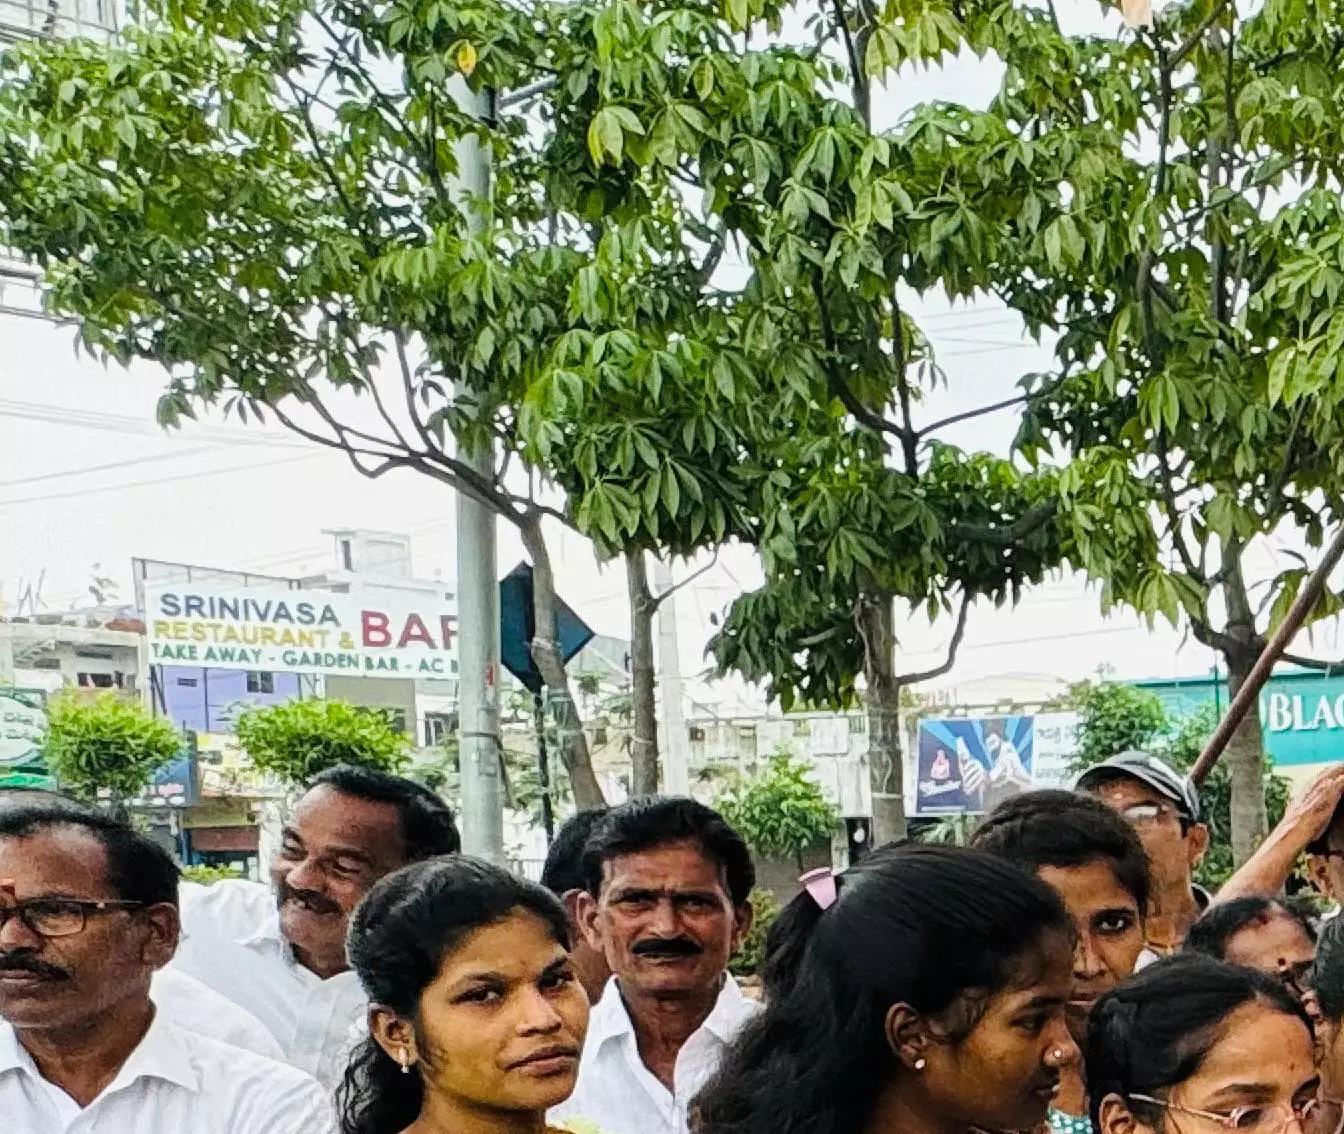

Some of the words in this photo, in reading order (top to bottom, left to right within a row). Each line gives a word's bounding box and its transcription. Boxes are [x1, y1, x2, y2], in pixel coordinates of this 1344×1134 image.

[160, 592, 342, 627] SRINIVASA
[153, 620, 331, 648] RESTAURANT
[338, 630, 355, 649] &
[151, 643, 198, 660] TAKE
[204, 646, 262, 663] AWAY
[282, 650, 359, 670] GARDEN
[364, 656, 399, 673] BAR
[419, 657, 444, 674] AC
